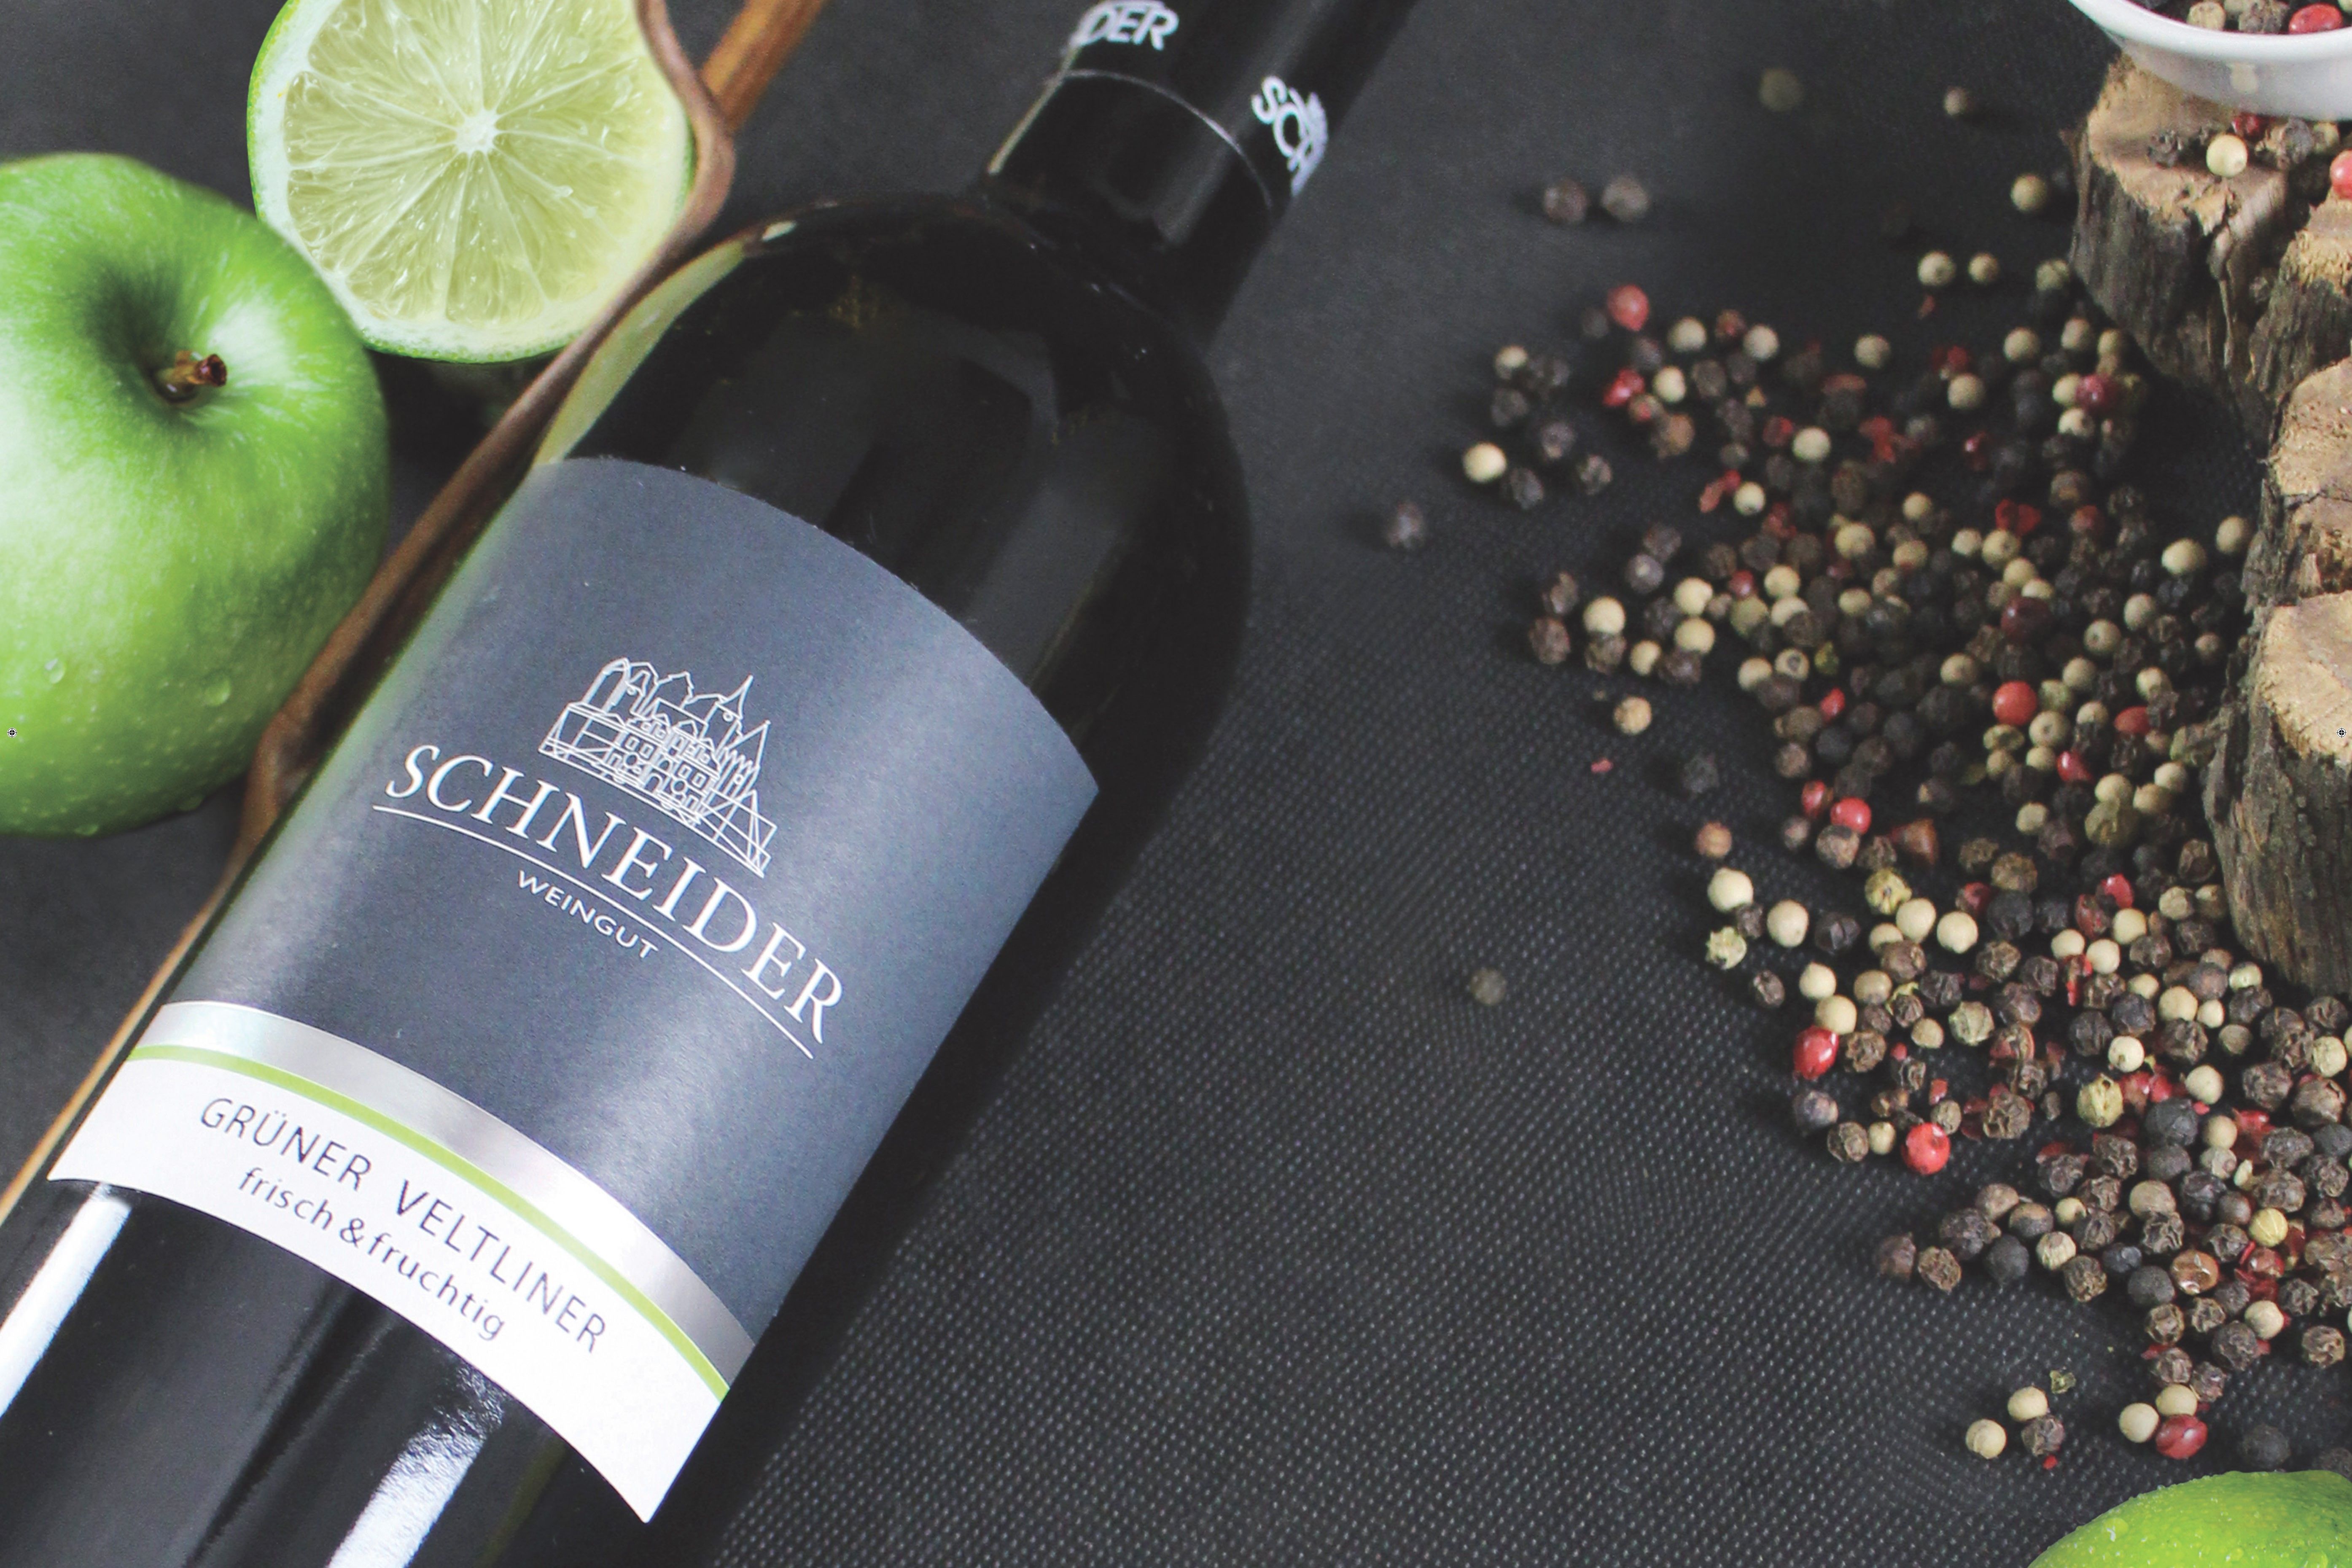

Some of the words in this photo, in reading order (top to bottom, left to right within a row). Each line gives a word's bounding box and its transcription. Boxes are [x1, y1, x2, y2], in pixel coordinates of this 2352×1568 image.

[385, 744, 843, 1044] SCHNEIDER
[519, 869, 659, 958] WEINGUT
[200, 1097, 372, 1192] GRÜNER
[396, 1178, 606, 1354] VELTLINER
